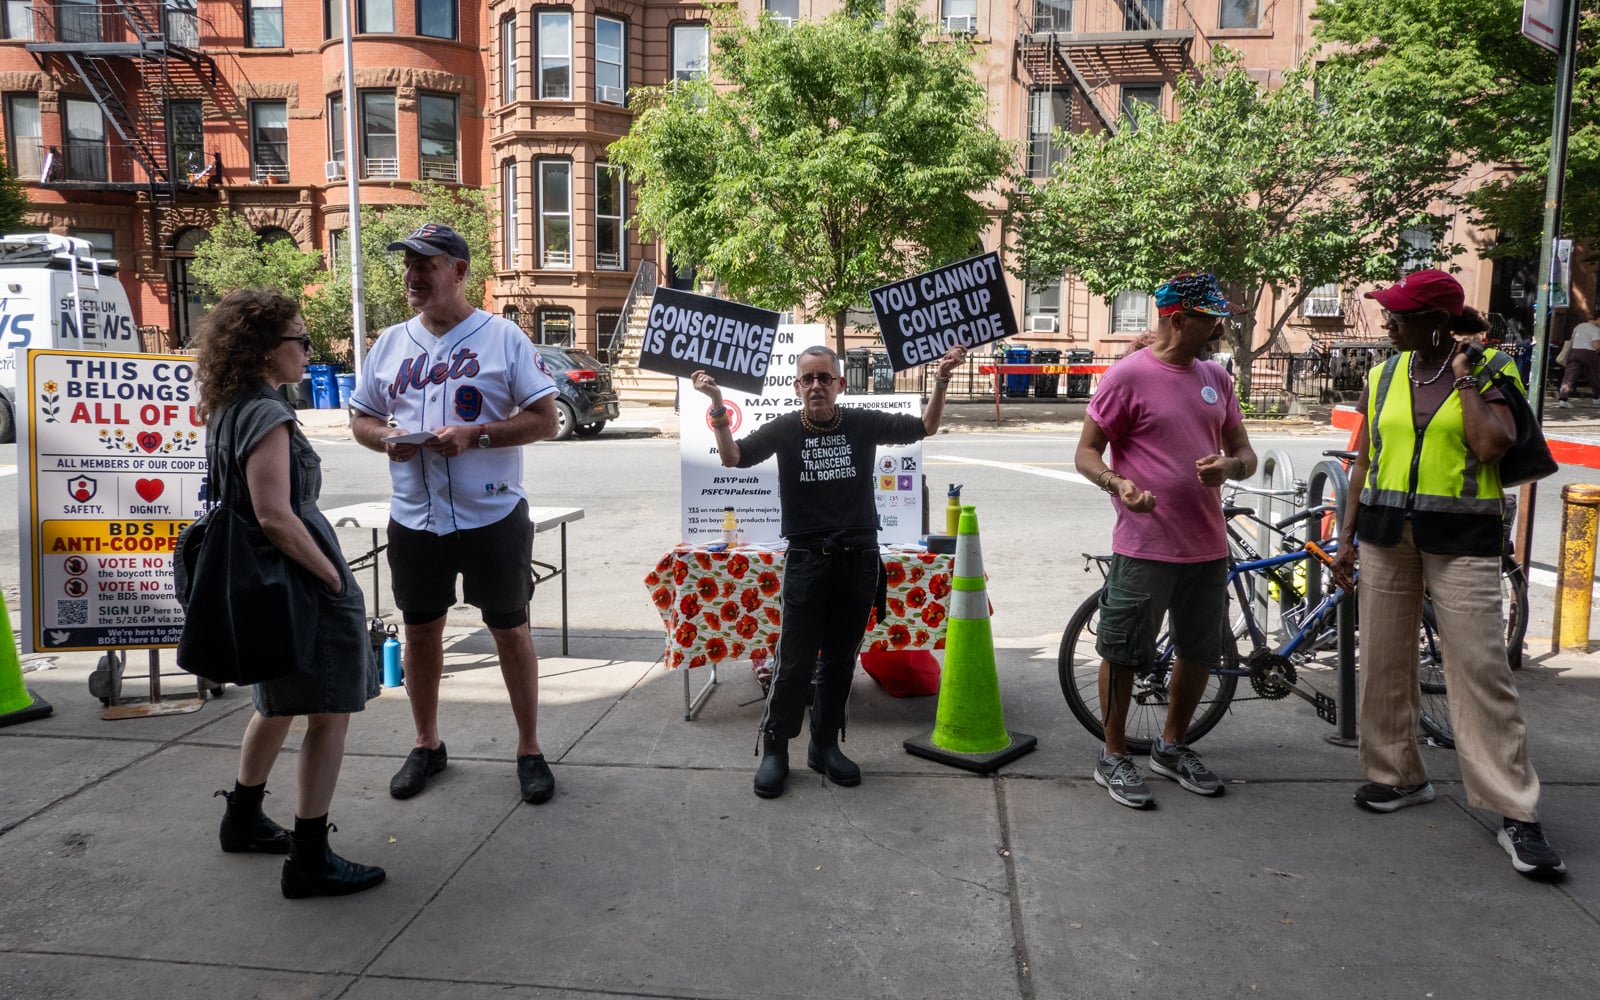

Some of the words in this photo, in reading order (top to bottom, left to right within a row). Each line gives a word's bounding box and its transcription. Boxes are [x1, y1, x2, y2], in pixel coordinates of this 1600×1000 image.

[875, 282, 917, 315] YOU
[920, 256, 997, 301] CANNOT
[898, 297, 965, 337] COVER
[965, 288, 991, 316] UP
[61, 311, 131, 341] NEWS
[650, 303, 775, 354] CONSCIENCE
[777, 332, 794, 343] ON
[902, 313, 1005, 365] GENOCIDE
[643, 328, 666, 355] IS
[670, 333, 768, 377] CALLING
[66, 359, 138, 381] THIS
[388, 348, 480, 399] Mets
[67, 381, 190, 402] BELONGS
[454, 384, 483, 422] 9
[745, 398, 780, 407] MAY
[857, 401, 912, 409] ENDORSEMENTS
[70, 402, 130, 425] ALL
[140, 404, 179, 426] OF
[754, 413, 762, 421] 7
[805, 437, 820, 448] THE
[821, 434, 847, 447] ASHES
[801, 449, 810, 460] OF
[812, 444, 852, 459] GENOCIDE
[57, 459, 77, 468] ALL
[80, 459, 130, 469] MEMBERS
[133, 459, 145, 469] OF
[148, 460, 168, 470] OUR
[171, 460, 195, 470] COOP
[803, 456, 851, 470] TRANSCEND
[713, 476, 738, 484] RSVP
[738, 476, 759, 484] with
[800, 471, 816, 482] ALL
[817, 466, 857, 481] BORDERS
[63, 504, 104, 514] SAFETY.
[130, 505, 171, 515] DIGNITY.
[109, 523, 154, 535] BDS
[169, 523, 187, 536] IS
[98, 558, 137, 569] VOTE
[142, 557, 163, 568] NO
[98, 570, 114, 578] the
[117, 569, 152, 579] boycott
[98, 581, 135, 592] VOTE
[140, 581, 159, 591] NO
[98, 592, 114, 601] the
[118, 592, 138, 600] BDS
[98, 606, 129, 615] SIGN
[134, 605, 151, 615] UP
[153, 607, 171, 615] here
[99, 617, 113, 625] the
[116, 616, 138, 624] 5/26
[158, 615, 171, 623] via
[135, 628, 155, 636] here
[98, 637, 117, 645] BDS
